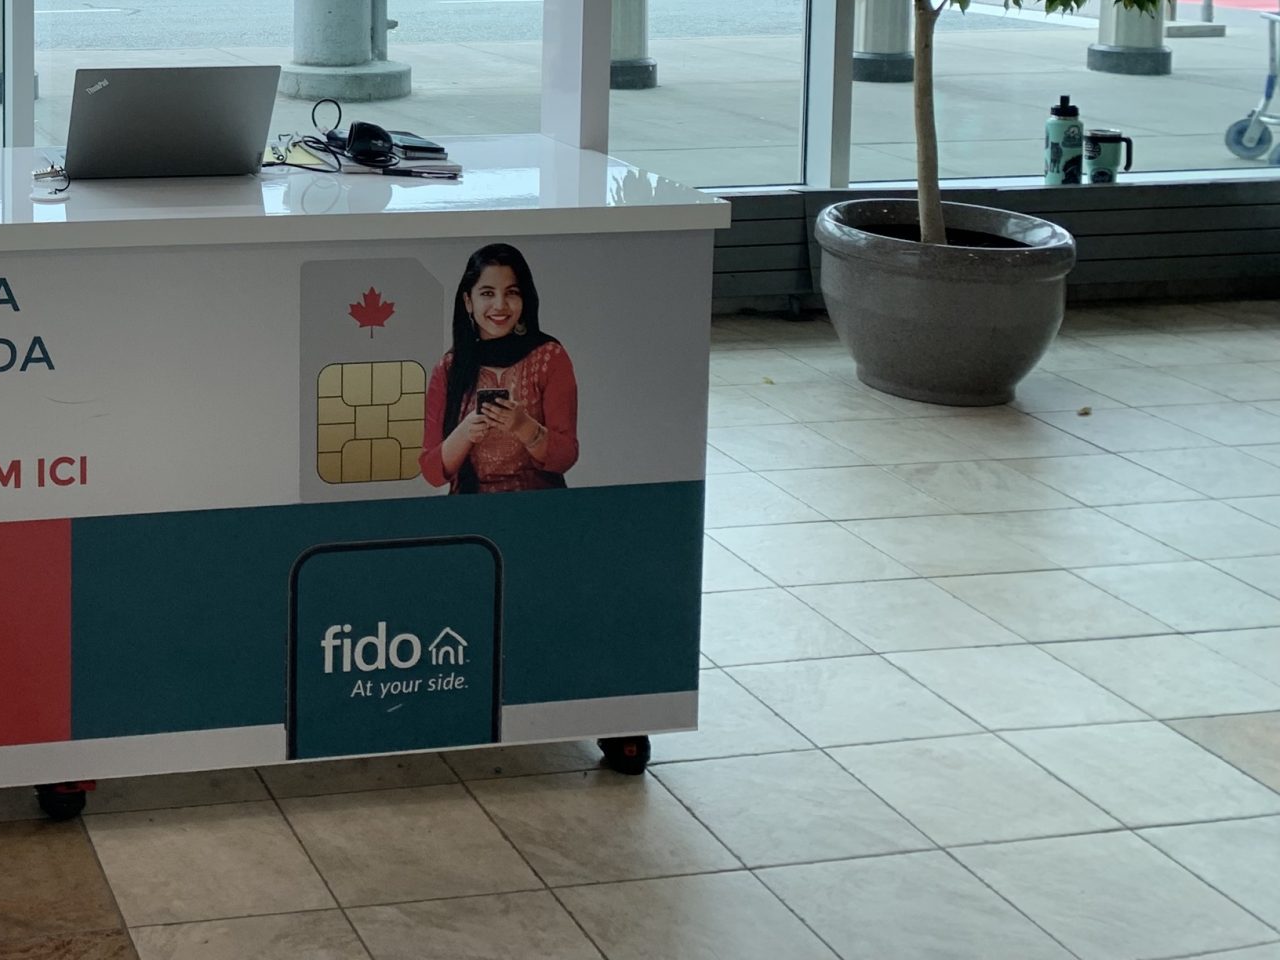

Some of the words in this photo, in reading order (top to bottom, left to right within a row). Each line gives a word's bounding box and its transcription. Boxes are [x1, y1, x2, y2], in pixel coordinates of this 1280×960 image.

[85, 78, 110, 96] ThinkPad
[37, 455, 88, 488] ICI
[320, 621, 423, 674] fido
[350, 680, 374, 698] At
[380, 679, 423, 699] your
[427, 672, 469, 692] side.
